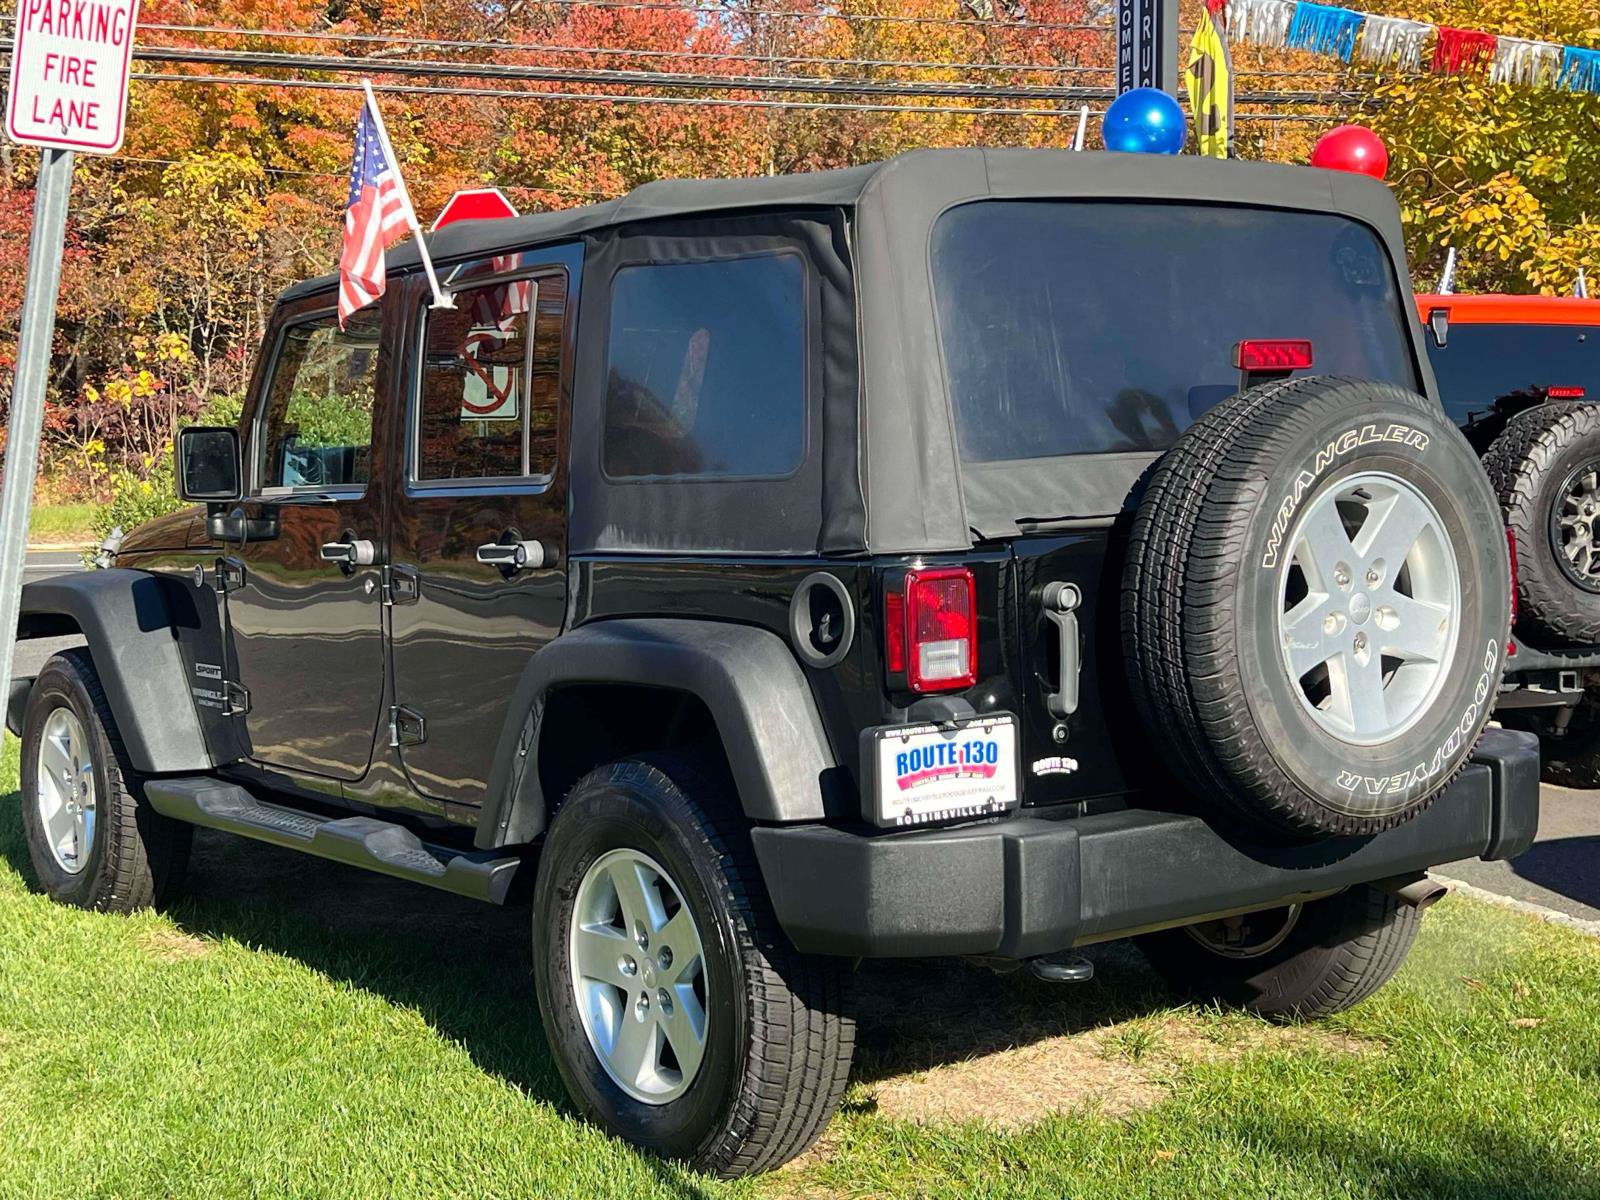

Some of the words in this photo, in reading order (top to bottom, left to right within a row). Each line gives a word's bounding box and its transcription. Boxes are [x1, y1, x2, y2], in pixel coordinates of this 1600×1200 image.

[27, 0, 127, 47] PARKING
[43, 53, 97, 87] FIRE
[32, 95, 101, 130] LANE
[1261, 422, 1431, 569] WRANGLER
[1335, 637, 1498, 796] GOODYEAR
[896, 742, 958, 777] ROUTE
[962, 740, 999, 765] 130
[992, 801, 1006, 812] NJ
